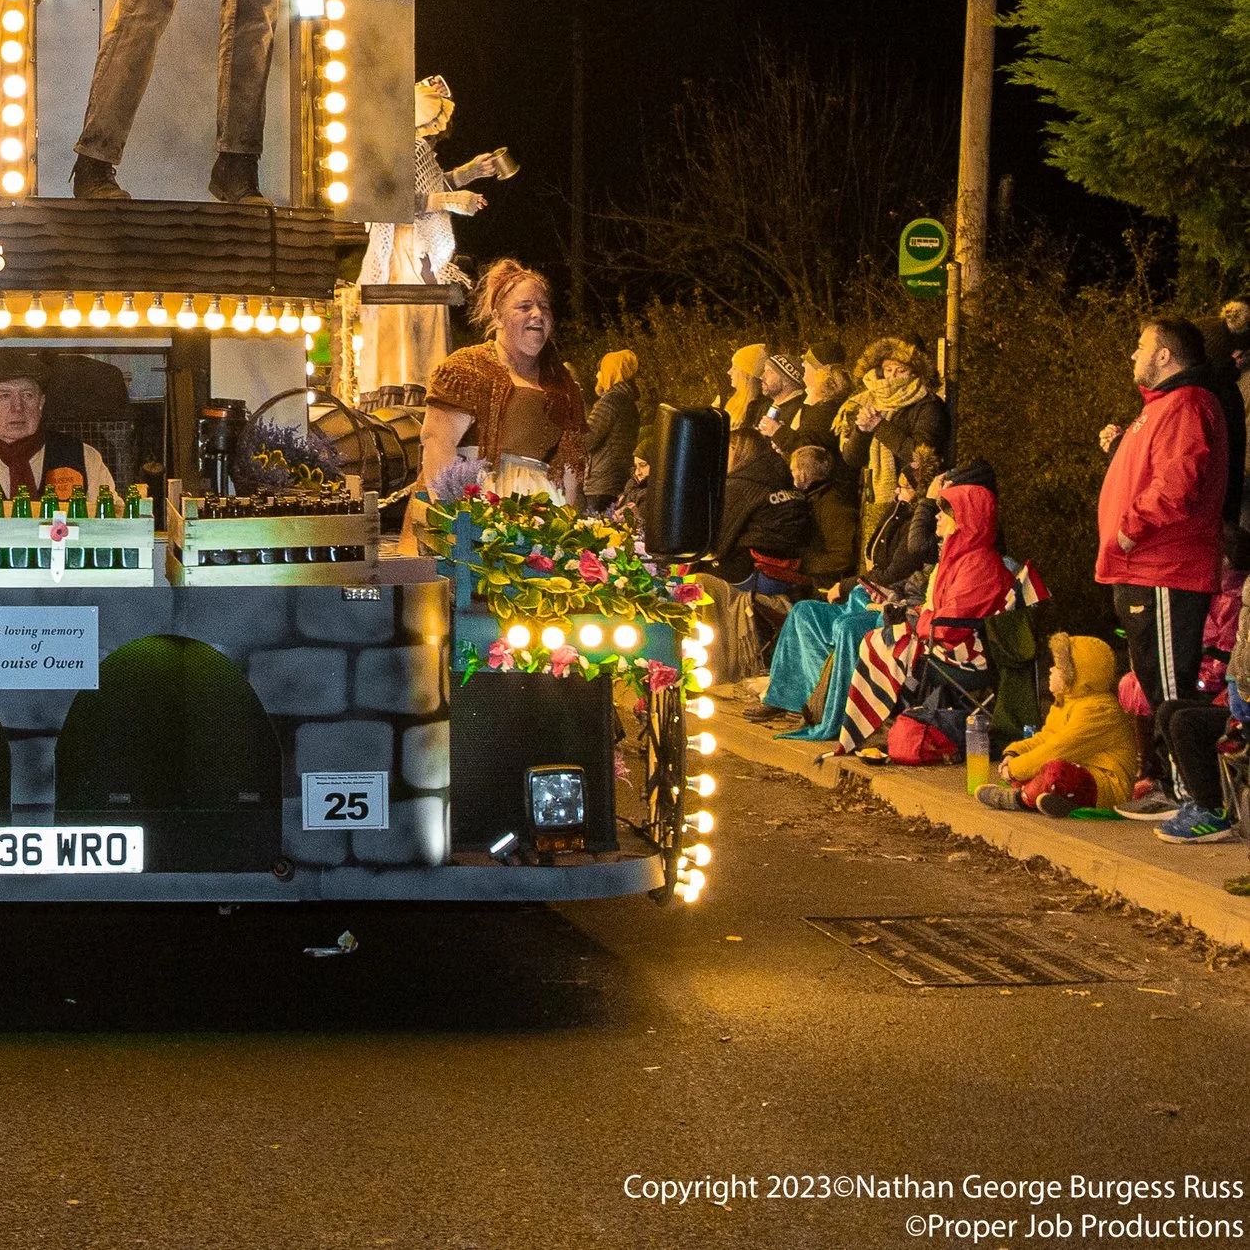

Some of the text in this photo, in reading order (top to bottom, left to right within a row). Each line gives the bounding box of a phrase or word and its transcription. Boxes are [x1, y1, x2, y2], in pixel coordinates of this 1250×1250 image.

[4, 626, 38, 639] loving
[42, 628, 85, 639] memory
[31, 640, 43, 653] of
[42, 656, 85, 670] Owen
[324, 792, 369, 820] 25
[57, 832, 127, 867] WRO
